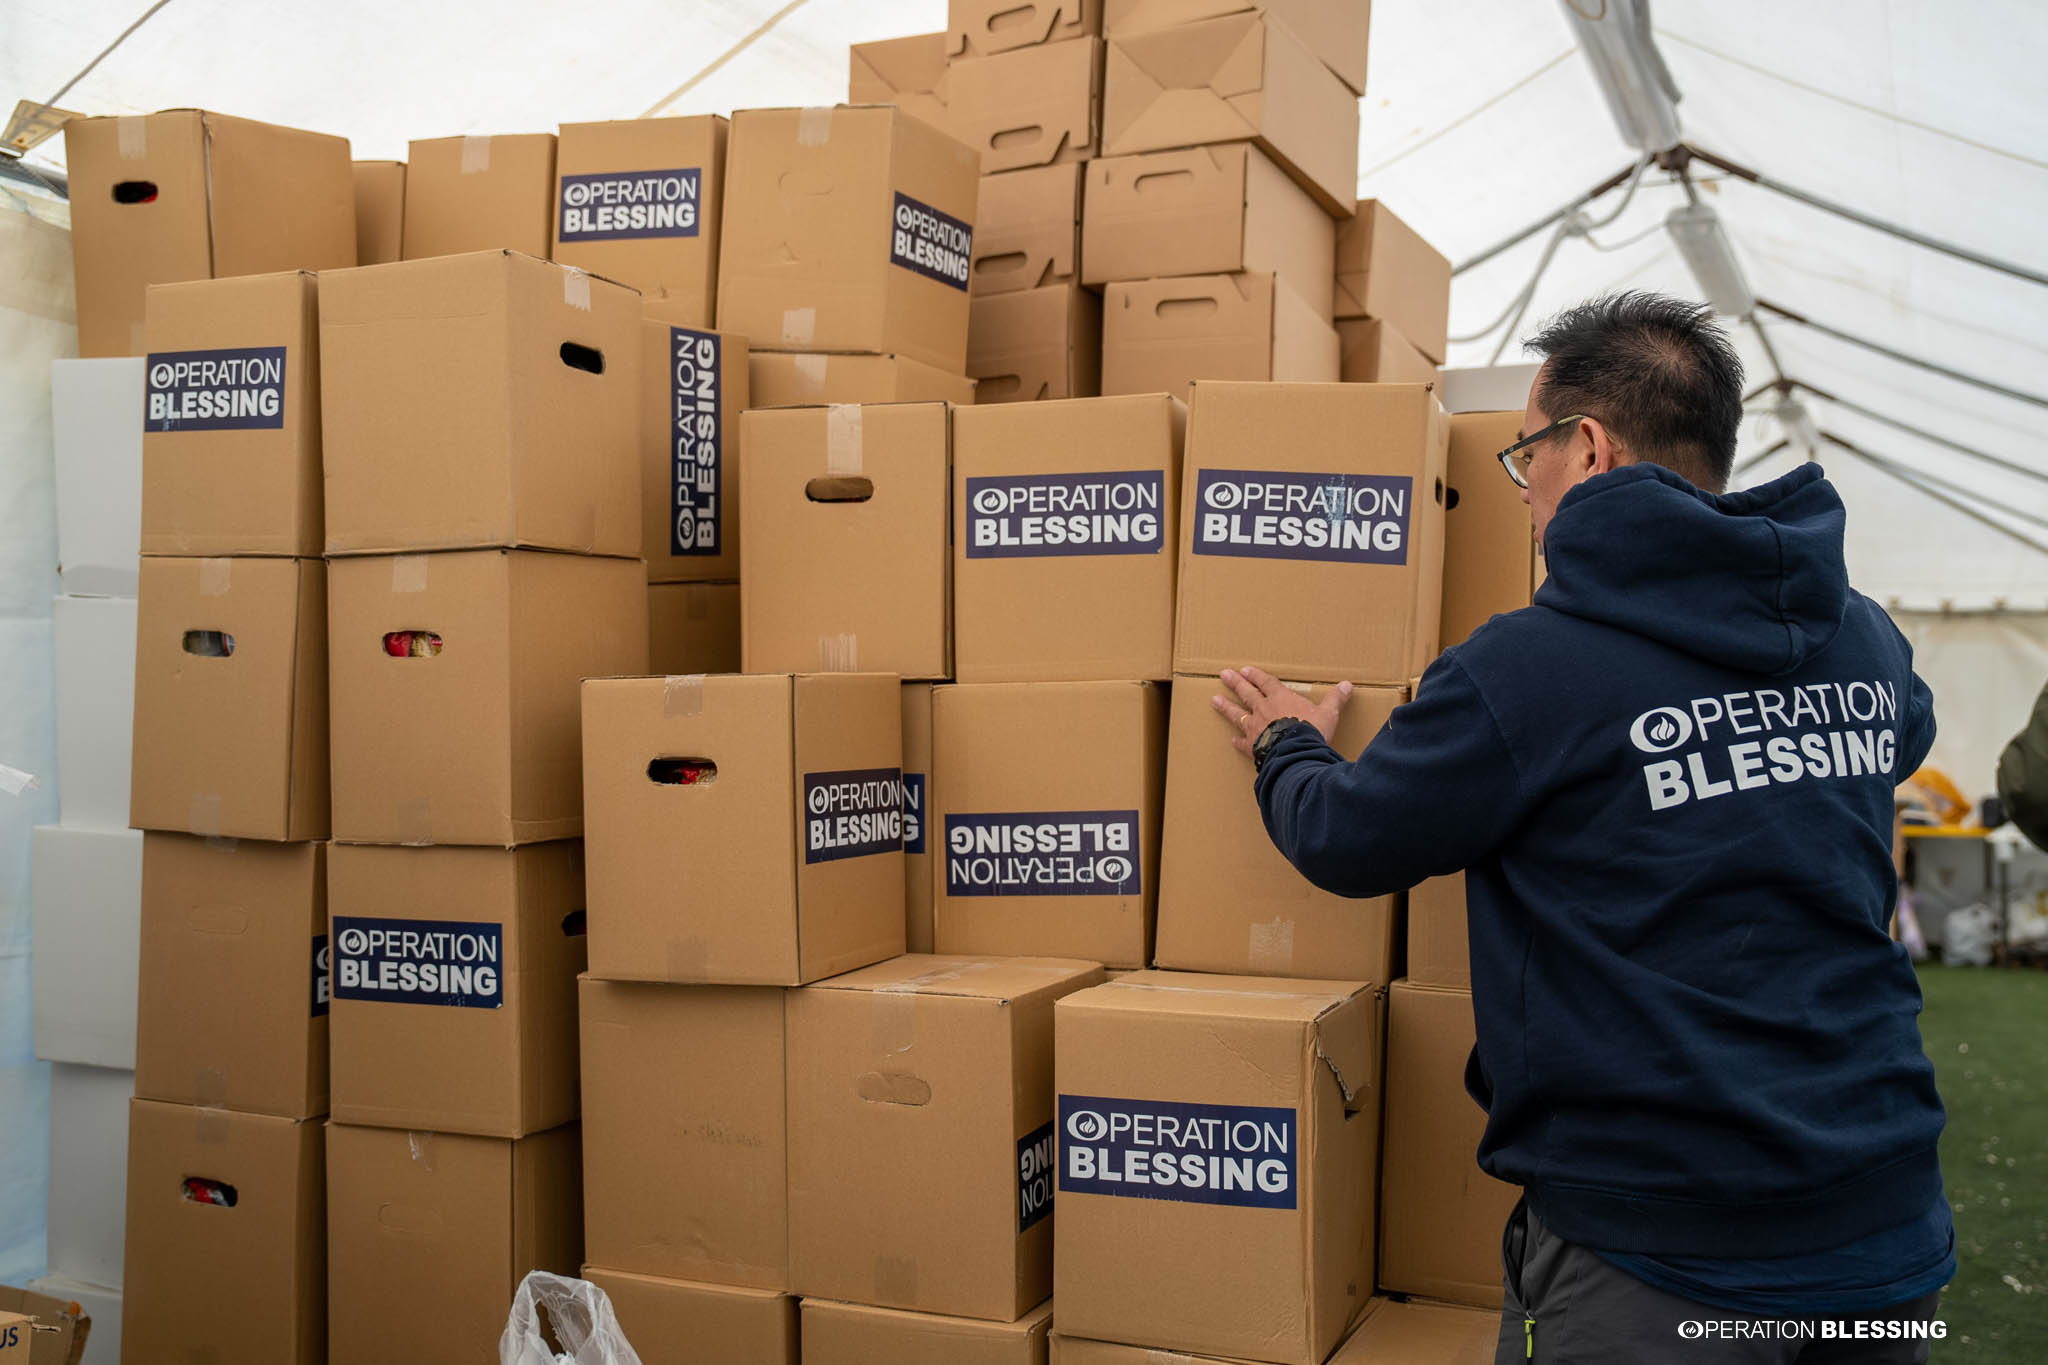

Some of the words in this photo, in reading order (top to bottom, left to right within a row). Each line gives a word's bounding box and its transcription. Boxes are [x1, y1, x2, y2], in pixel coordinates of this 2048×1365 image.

[564, 176, 697, 206] OPERATION
[564, 202, 696, 233] BLESSING
[896, 204, 972, 256] OPERATION
[894, 230, 969, 282] BLESSING
[150, 358, 281, 389] OPERATION
[150, 388, 280, 420] BLESSING
[677, 334, 696, 550] OPERATION
[696, 338, 715, 548] BLESSING
[973, 482, 1157, 514] OPERATION
[1204, 481, 1404, 517] OPERATION
[975, 513, 1158, 547] BLESSING
[1203, 513, 1401, 552] BLESSING
[1629, 680, 1897, 753] OPERATION
[1643, 729, 1896, 811] BLESSING
[808, 780, 901, 815] OPERATION
[810, 810, 901, 851] BLESSING
[951, 822, 1130, 855] BLESSING
[952, 855, 1133, 885] OPERATION
[338, 928, 497, 962] OPERATION
[340, 959, 497, 996] BLESSING
[1066, 1110, 1288, 1154] OPERATION
[1069, 1145, 1289, 1193] BLESSING
